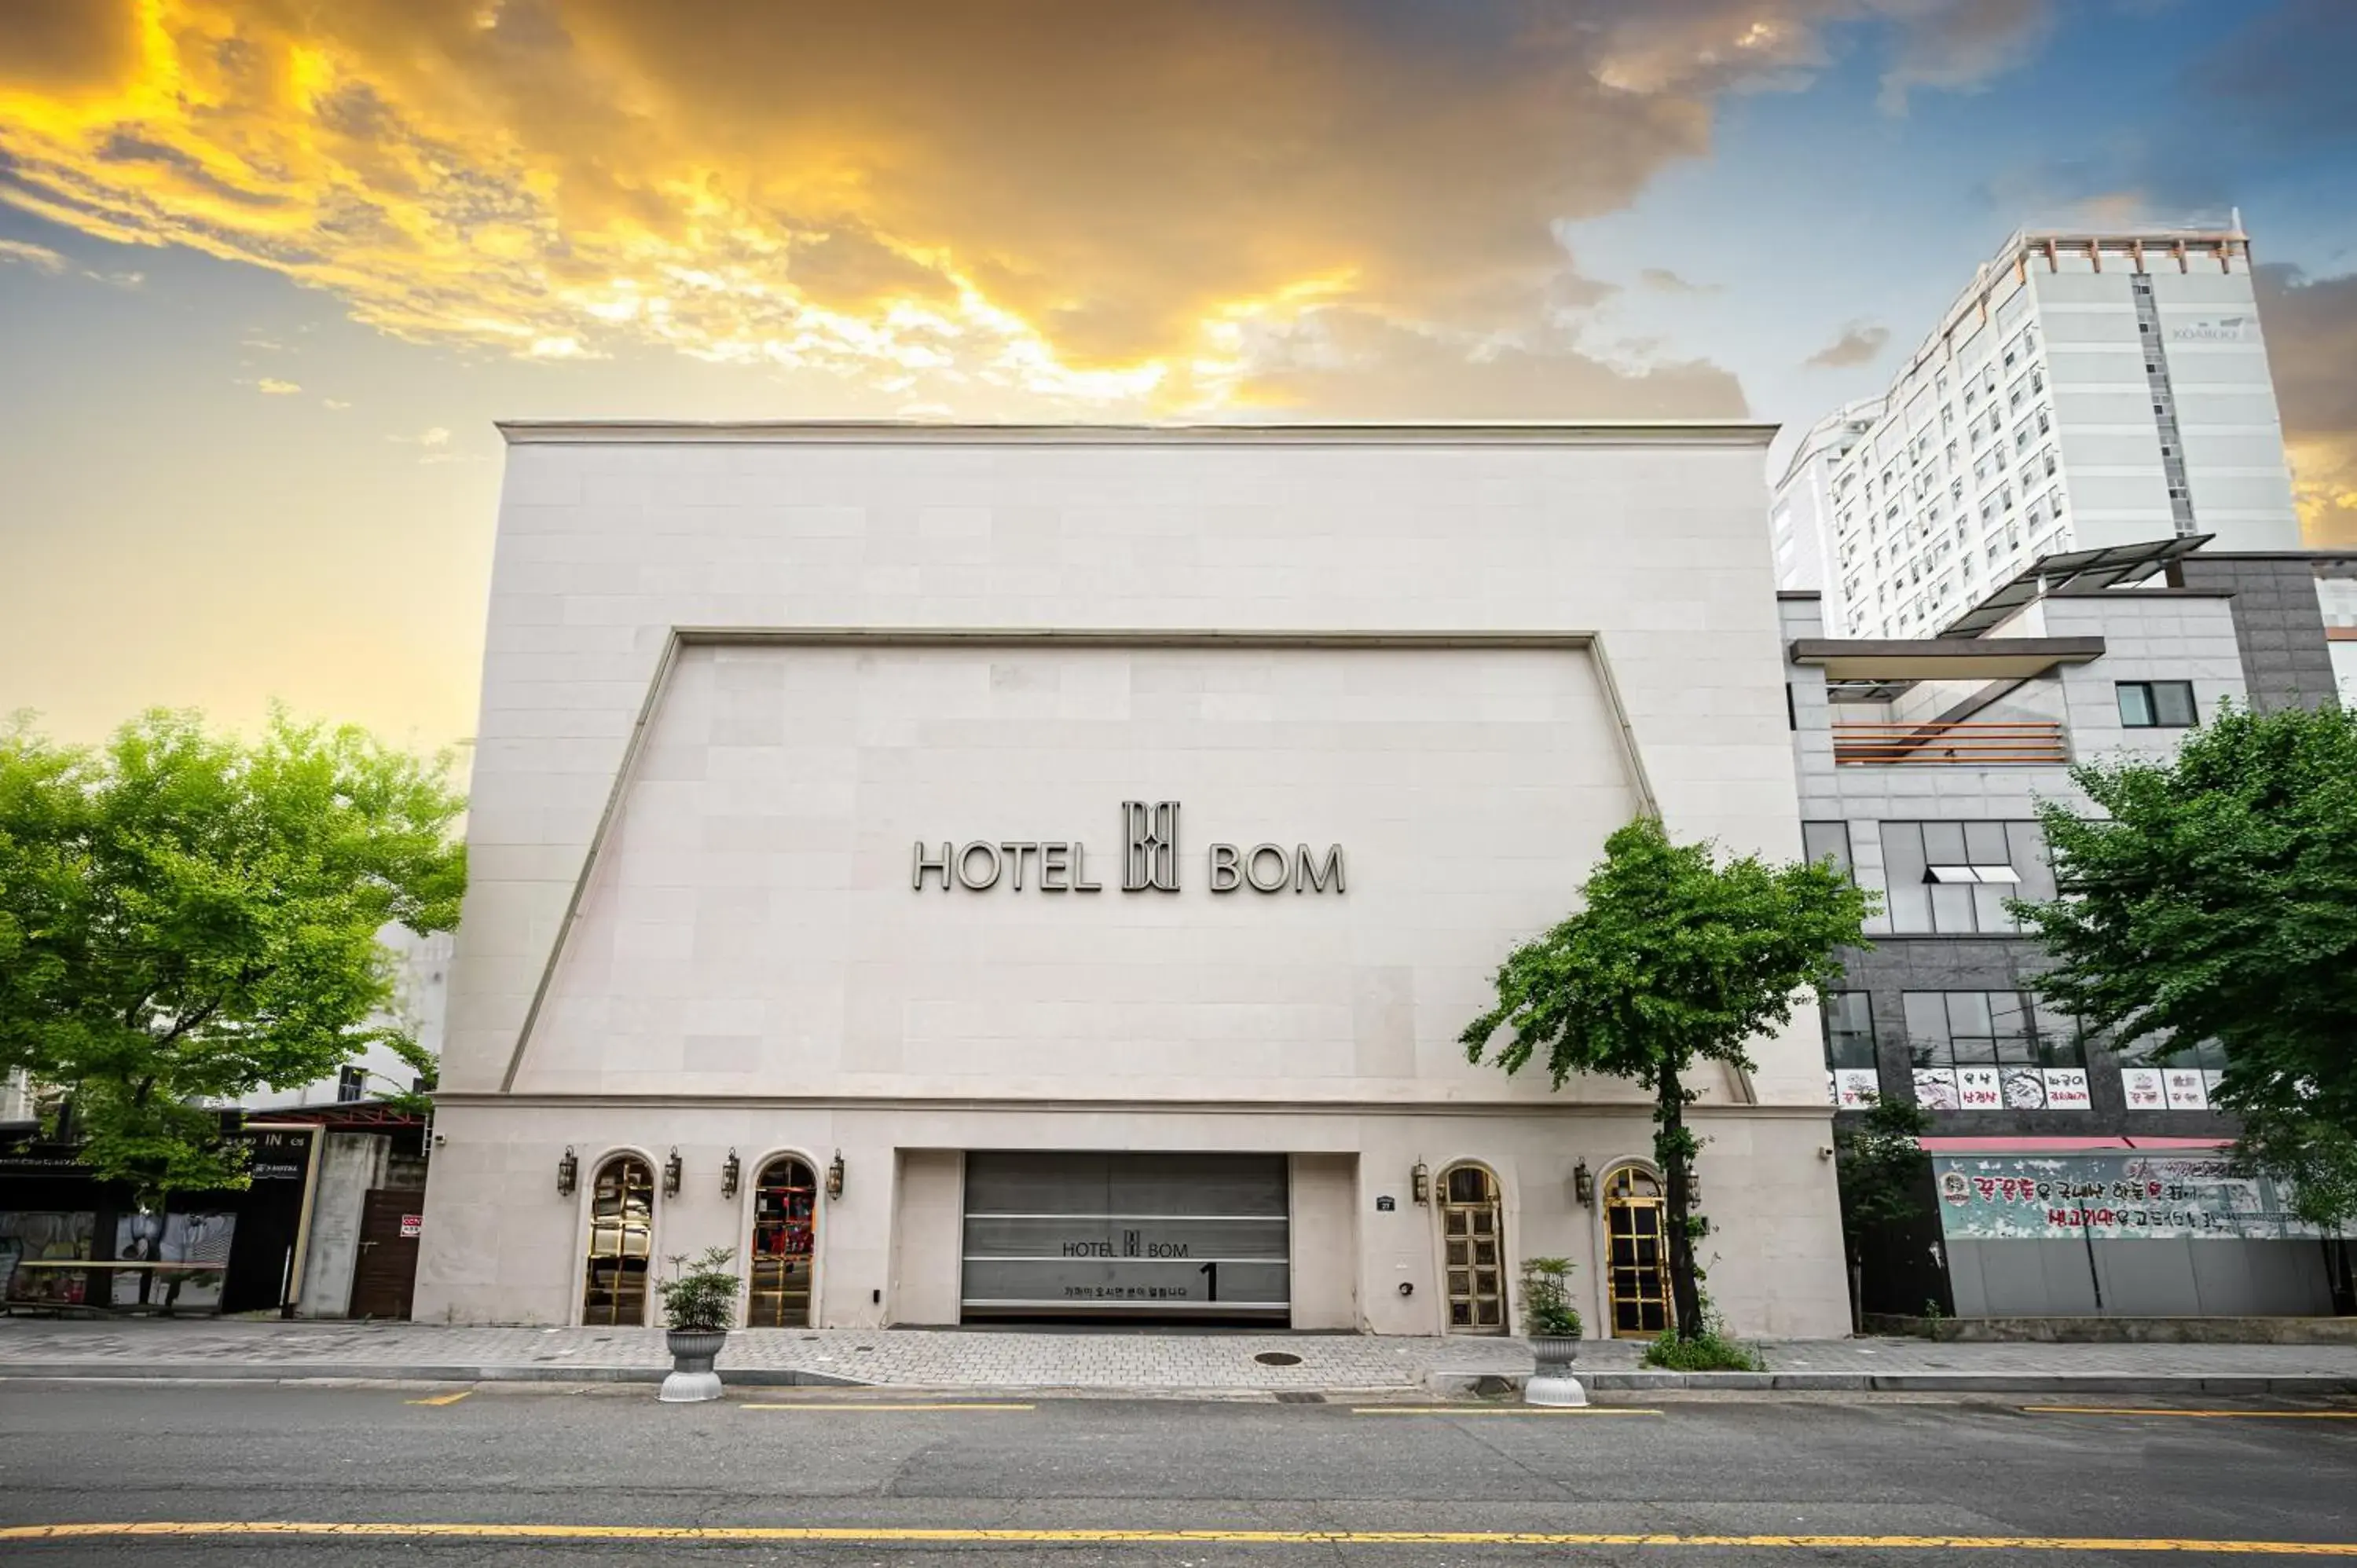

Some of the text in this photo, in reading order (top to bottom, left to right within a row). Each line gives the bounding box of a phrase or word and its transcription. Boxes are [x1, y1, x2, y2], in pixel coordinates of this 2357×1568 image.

[913, 841, 1102, 892] HOTEL
[1208, 842, 1346, 893] BOM
[1063, 1241, 1118, 1258] HOTEL
[1148, 1242, 1189, 1258] BOM
[1148, 1286, 1188, 1297] 열립니다
[1200, 1262, 1217, 1302] 1
